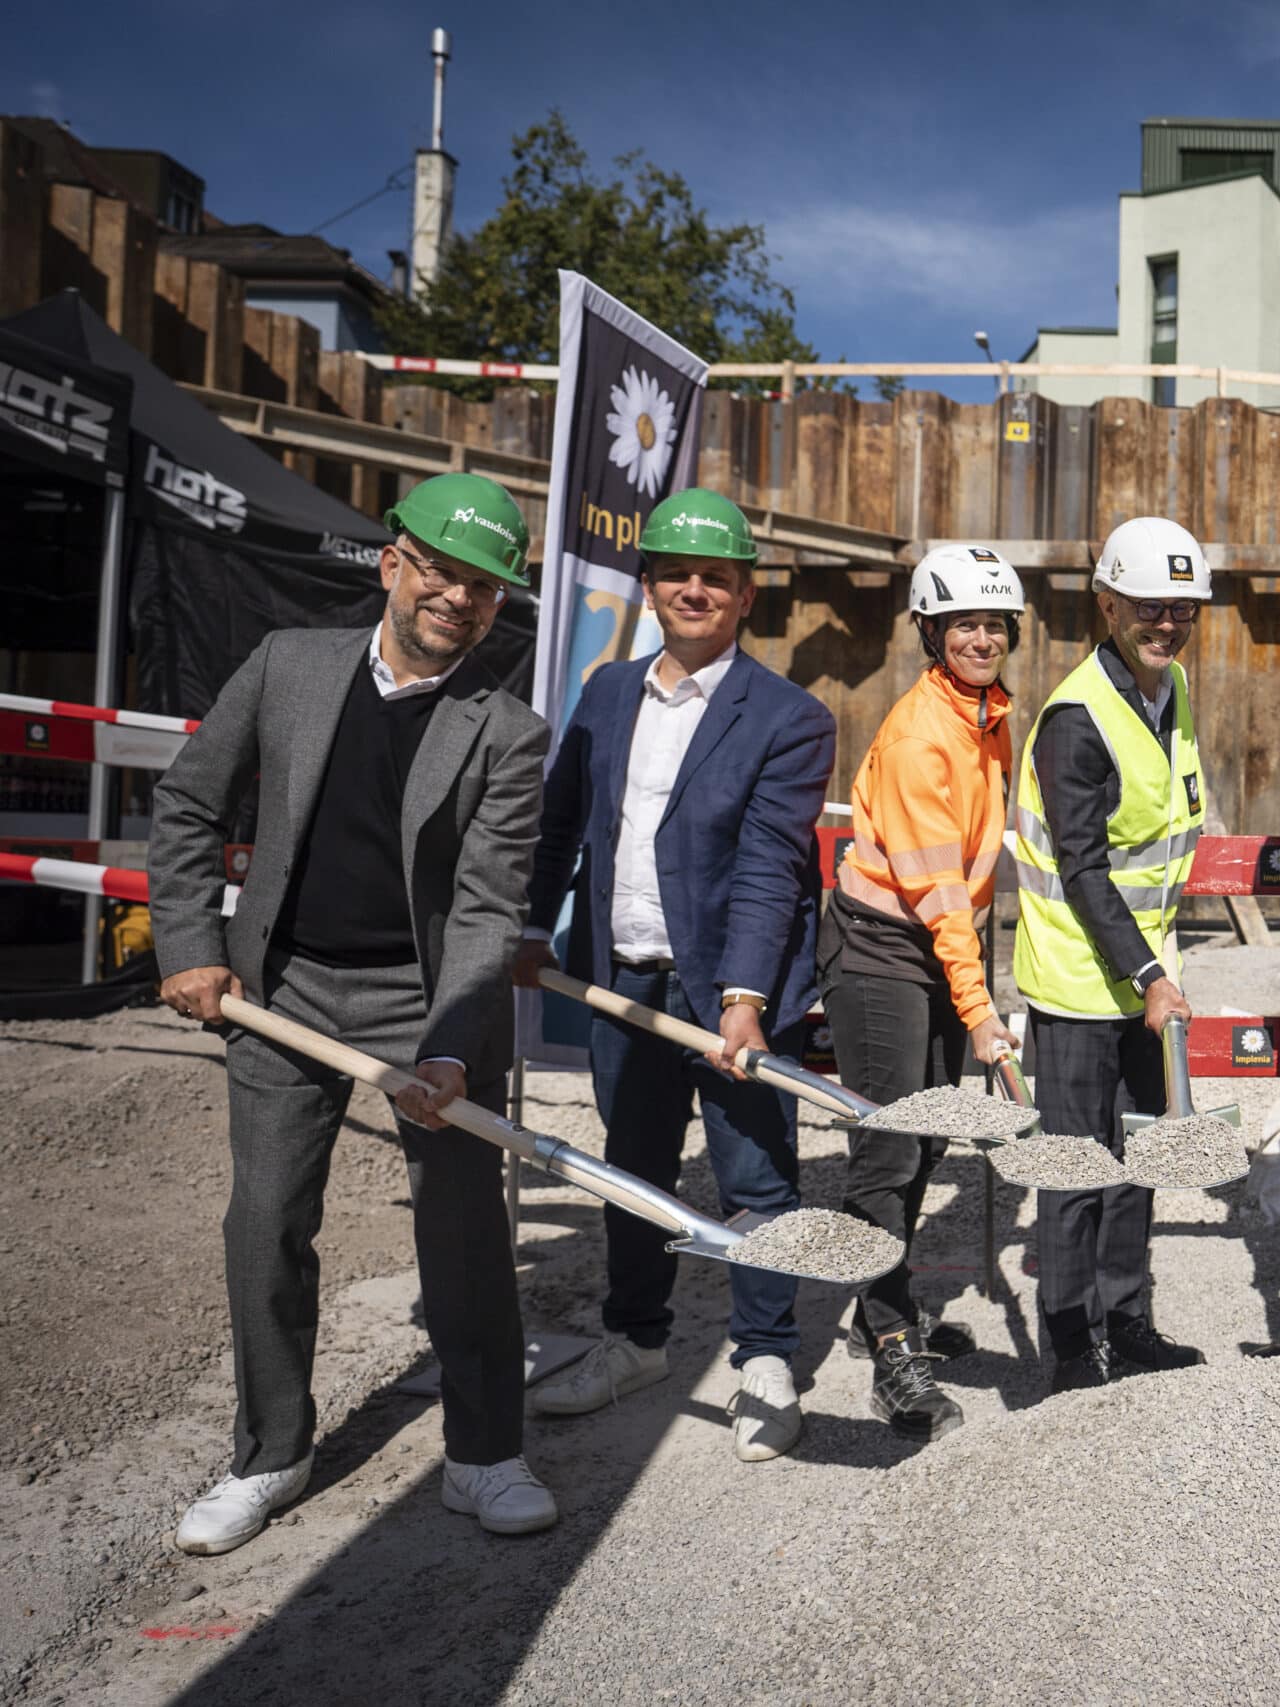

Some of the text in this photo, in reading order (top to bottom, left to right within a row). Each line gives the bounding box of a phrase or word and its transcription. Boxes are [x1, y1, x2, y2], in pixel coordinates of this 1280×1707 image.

[474, 515, 517, 544] vaudoise
[687, 516, 729, 532] vaudoise
[981, 584, 1012, 595] KASK
[1235, 1055, 1271, 1065] Implenia
